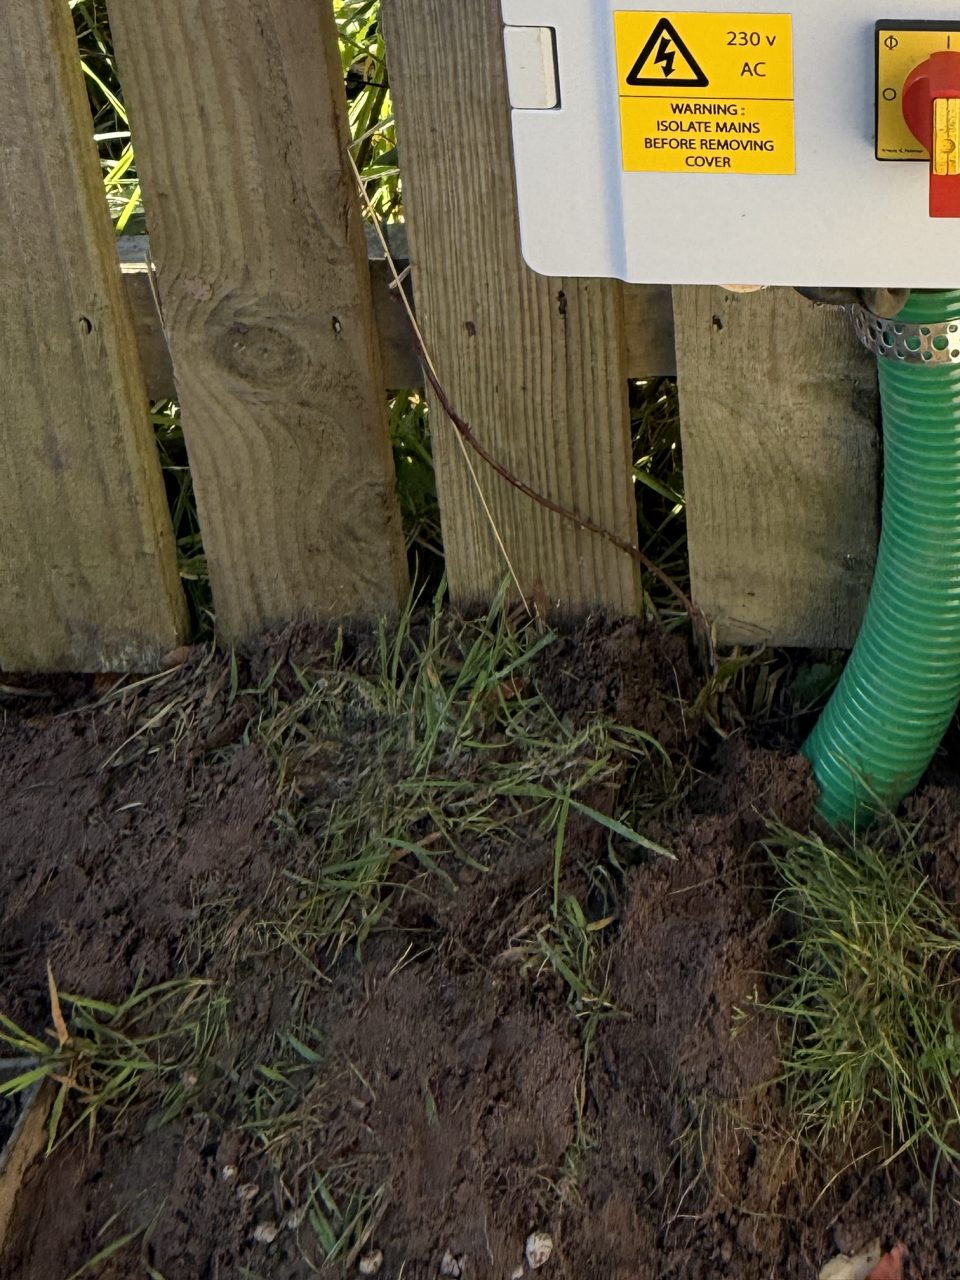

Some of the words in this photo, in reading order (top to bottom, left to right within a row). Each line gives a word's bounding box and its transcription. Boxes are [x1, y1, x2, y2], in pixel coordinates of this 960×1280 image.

[726, 31, 761, 47] 230
[740, 62, 766, 77] AC
[656, 120, 711, 133] ISOLATE
[715, 122, 760, 134] MAINS
[644, 138, 697, 150] BEFORE
[699, 140, 775, 152] REMOVING
[685, 156, 731, 168] COVER
